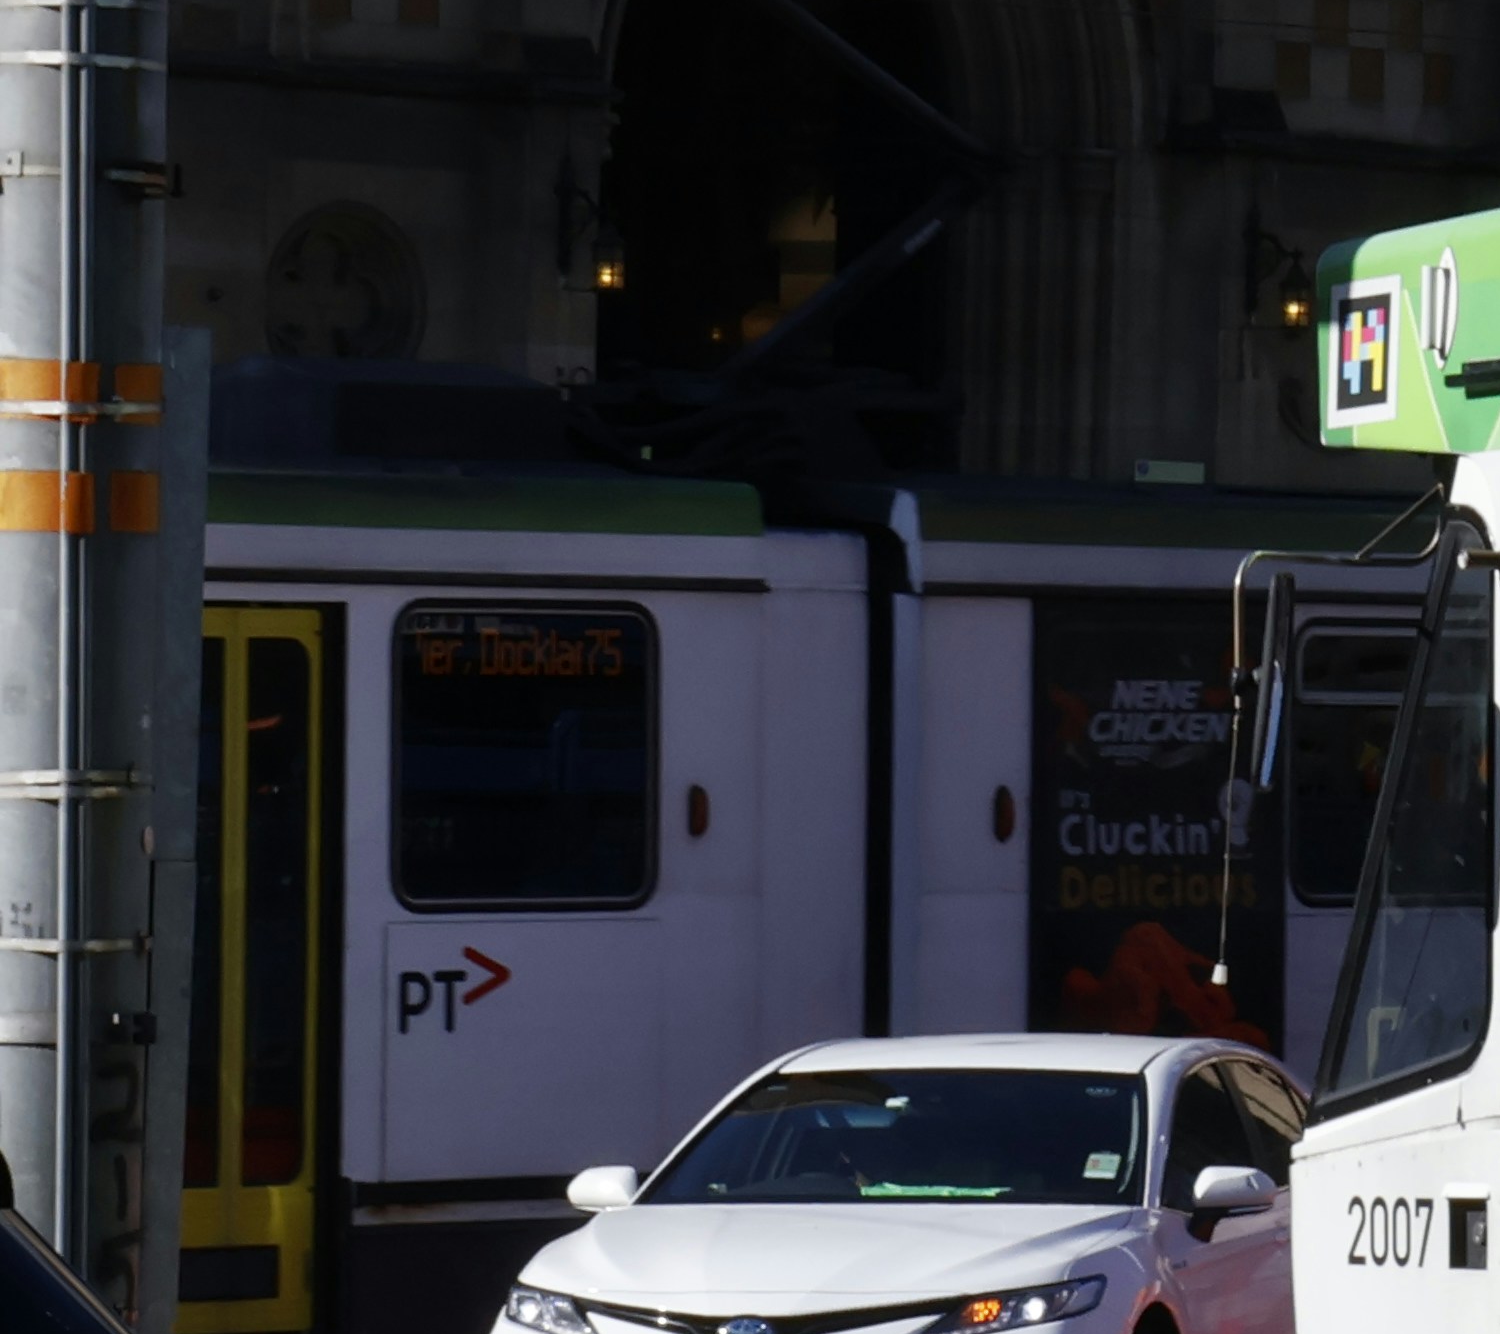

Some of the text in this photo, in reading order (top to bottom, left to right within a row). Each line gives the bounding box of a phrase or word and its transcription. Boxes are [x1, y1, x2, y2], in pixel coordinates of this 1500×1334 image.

[585, 628, 624, 677] 75
[1113, 679, 1203, 709] NENE
[1088, 712, 1231, 742] CHICKEN
[1059, 813, 1221, 855] Cluckin'
[1059, 864, 1257, 909] Delicious
[399, 970, 468, 1034] PT
[1347, 1195, 1434, 1268] 2007
